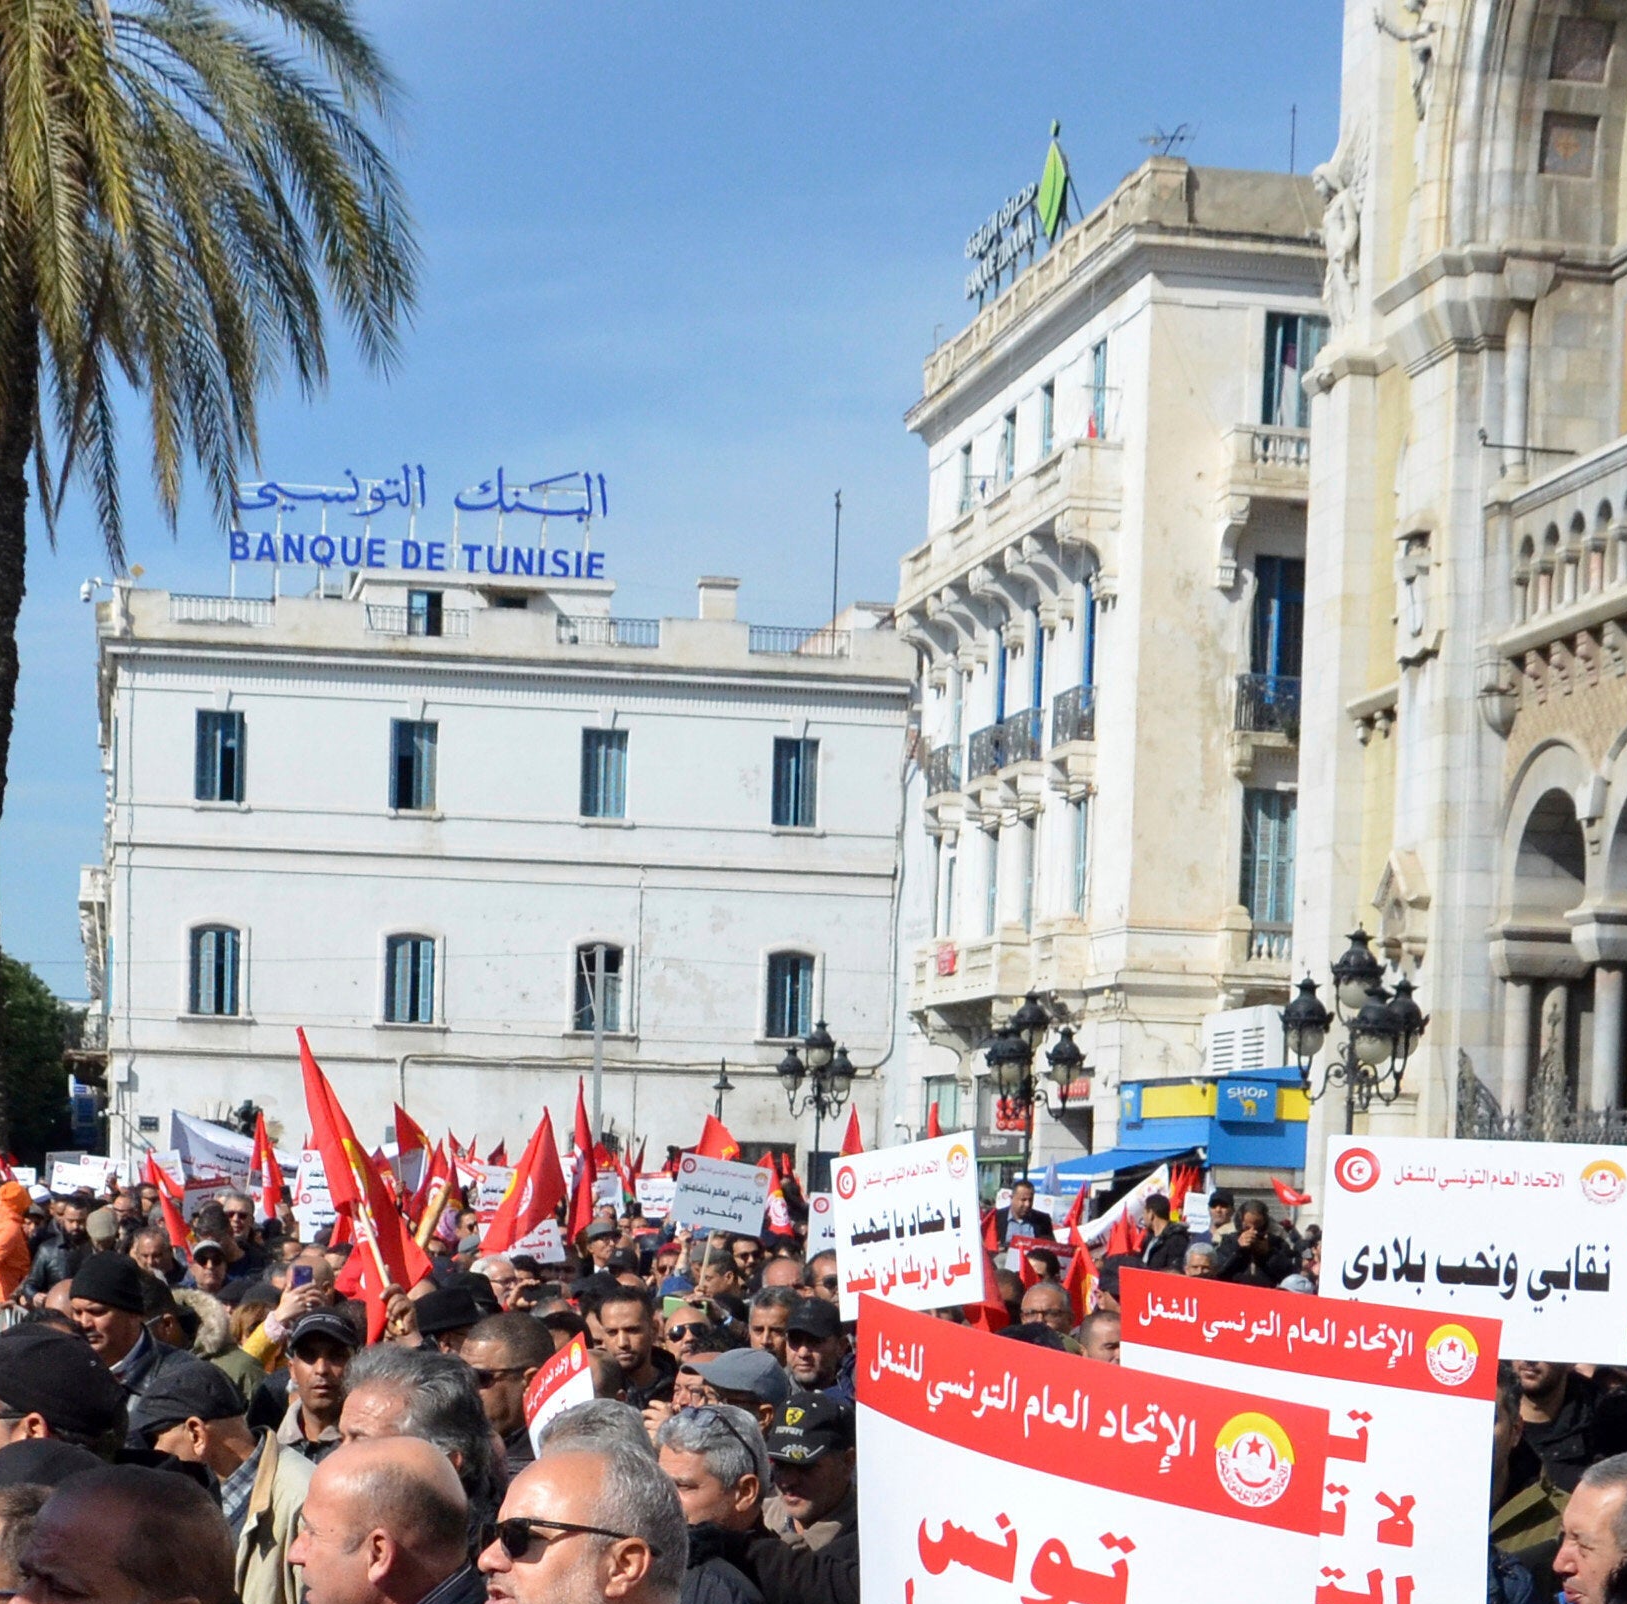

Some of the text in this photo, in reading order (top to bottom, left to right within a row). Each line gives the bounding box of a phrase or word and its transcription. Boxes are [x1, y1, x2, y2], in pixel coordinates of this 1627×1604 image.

[234, 463, 608, 522] البنك التونسي
[229, 530, 606, 579] BANQUE DE TUNISIE
[1226, 1086, 1268, 1099] SHOP
[1394, 1166, 1565, 1192] الاتحاد العام التونسي للشغل
[851, 1198, 962, 1252] يا حشاد يا شهيد
[880, 1257, 897, 1296] لن
[901, 1254, 938, 1290] دربك
[942, 1246, 971, 1286] على
[1342, 1236, 1426, 1301] بلادي
[1436, 1243, 1519, 1300] ونحب
[1527, 1243, 1611, 1313] نقابي
[1138, 1291, 1198, 1327] للشغل
[1202, 1309, 1281, 1343] التونسي
[1287, 1318, 1336, 1354] العام
[1344, 1325, 1414, 1369] الإتحاد
[870, 1331, 1197, 1475] الإتحاد العام التونسي للشغل
[1375, 1491, 1416, 1547] لا
